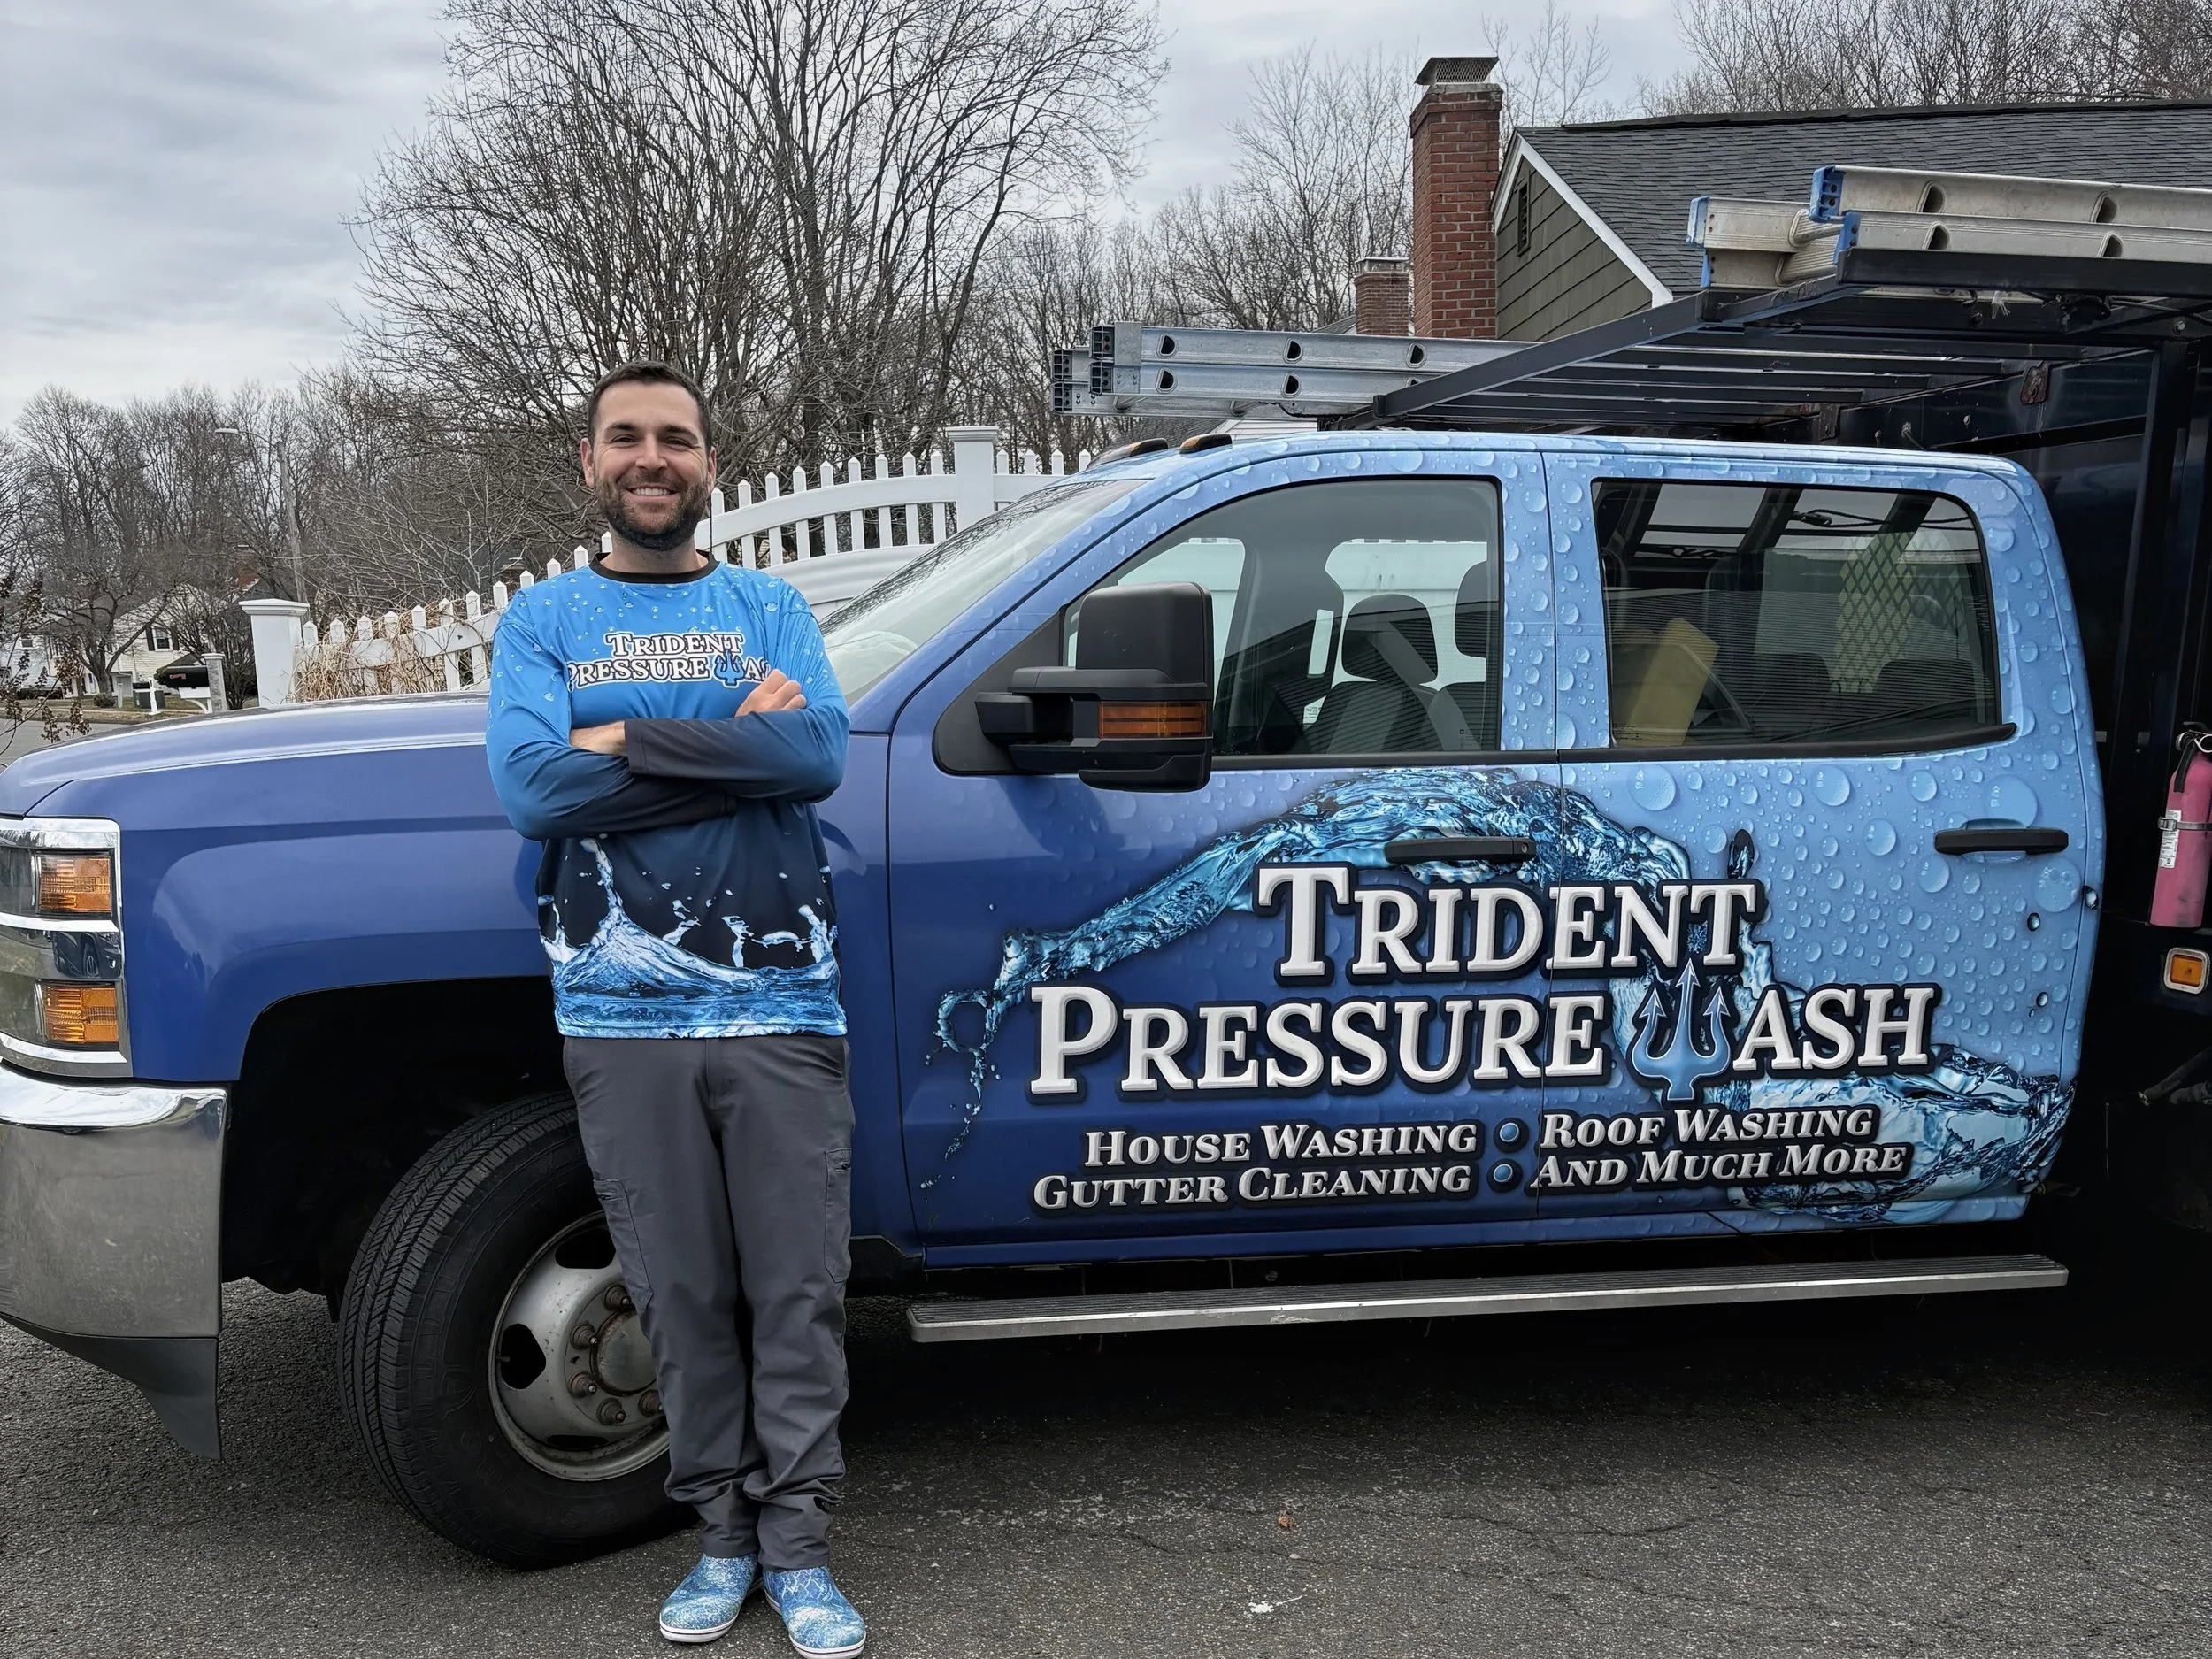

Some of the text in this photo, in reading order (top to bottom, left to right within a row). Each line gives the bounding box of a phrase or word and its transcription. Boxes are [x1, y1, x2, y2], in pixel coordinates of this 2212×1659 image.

[604, 632, 743, 657] TRIDENT
[1256, 865, 1757, 979] TRIDENT
[1029, 986, 1606, 1094] PRESSURE
[1084, 1107, 1874, 1168] HOUSE WASHING ROOF WASHING
[1033, 1143, 1908, 1210] GUTTER CLEANING AND MUCH MORE
